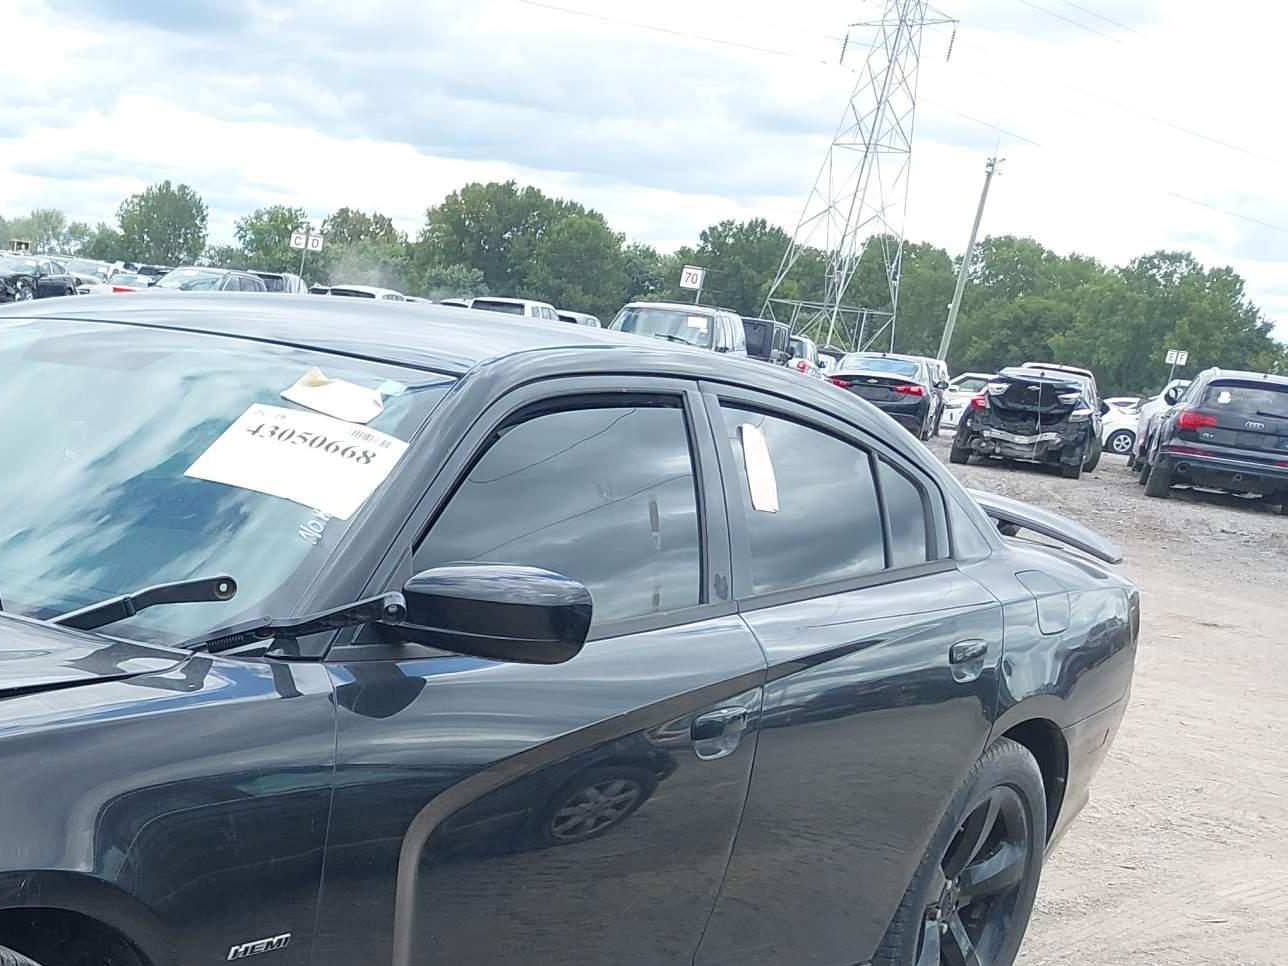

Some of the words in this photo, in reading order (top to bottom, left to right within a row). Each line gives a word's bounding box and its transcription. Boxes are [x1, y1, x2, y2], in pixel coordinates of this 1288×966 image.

[294, 236, 302, 246] C
[311, 238, 319, 249] D
[685, 271, 699, 285] 70
[246, 423, 377, 465] 43050668
[226, 932, 291, 961] HEMI
